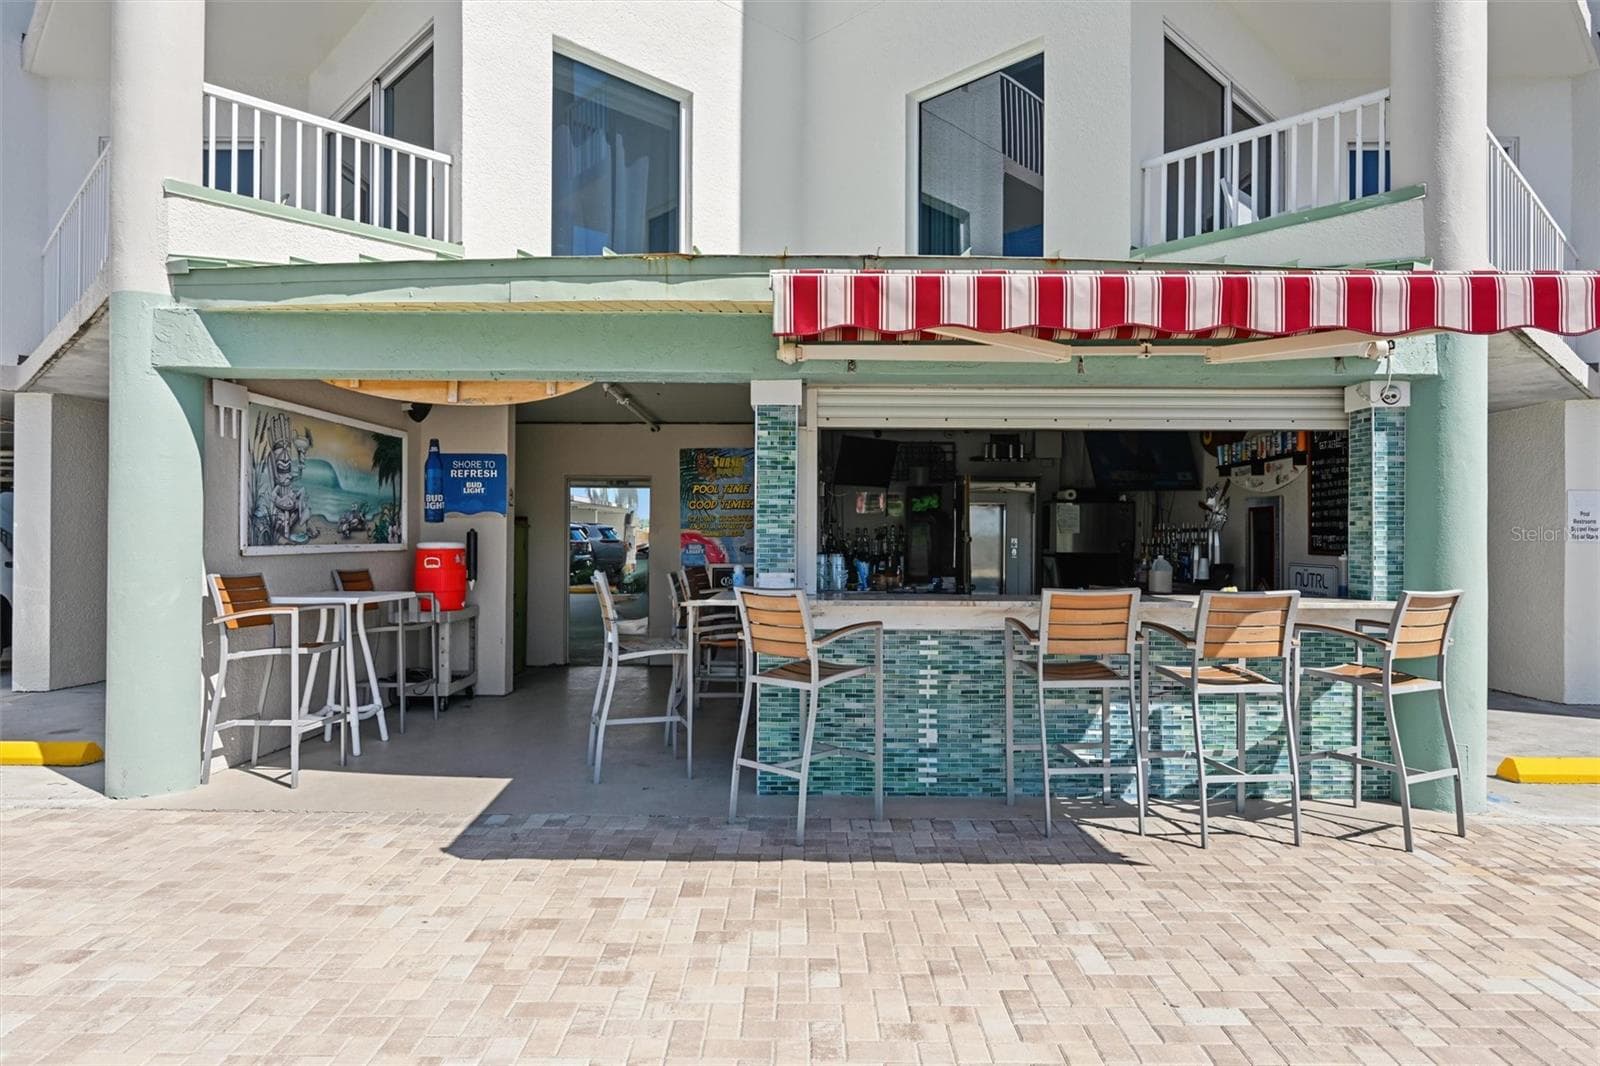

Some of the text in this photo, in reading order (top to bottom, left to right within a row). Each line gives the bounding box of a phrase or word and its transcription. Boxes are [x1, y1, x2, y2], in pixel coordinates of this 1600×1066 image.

[452, 460, 496, 469] SHORE TO
[450, 469, 498, 478] REFRESH
[692, 484, 751, 494] POOL TIME
[425, 494, 444, 502] BUD
[688, 500, 718, 510] GOOD
